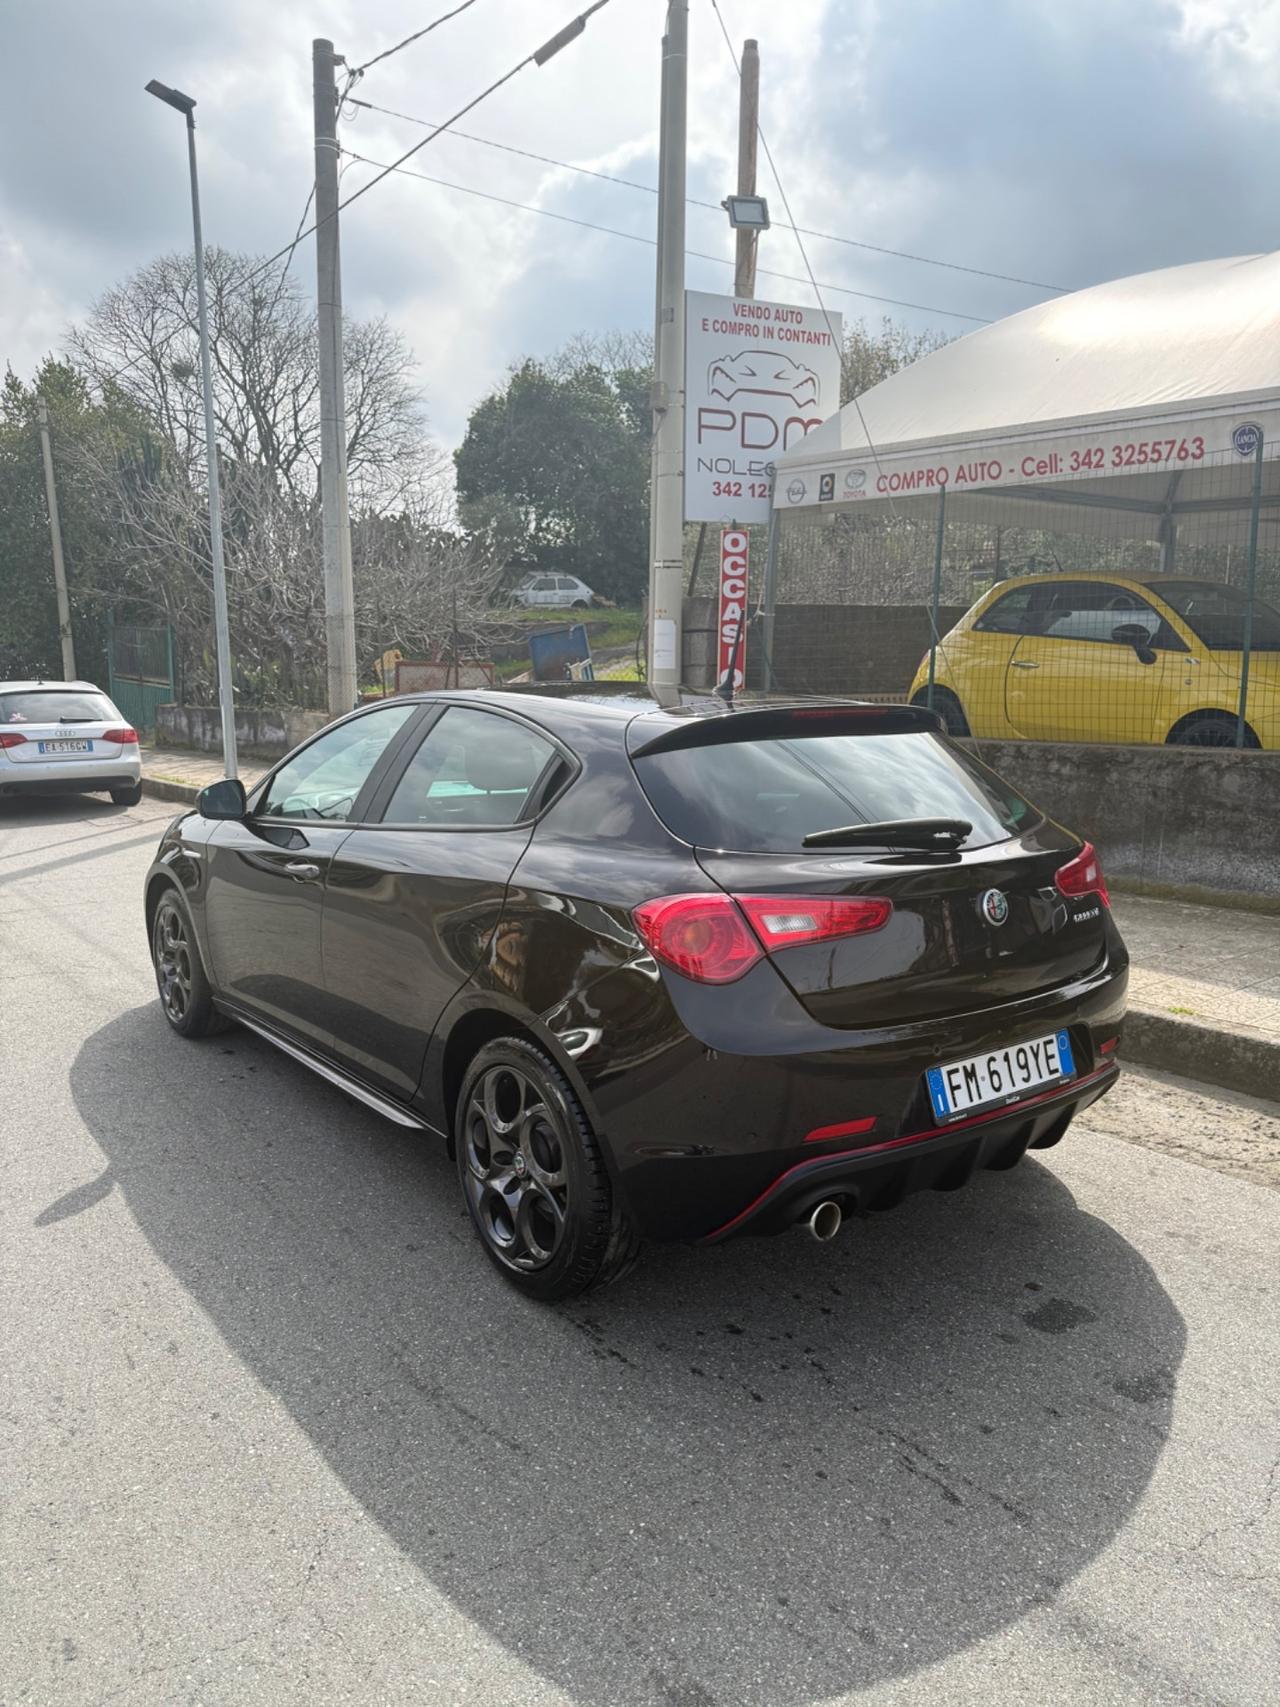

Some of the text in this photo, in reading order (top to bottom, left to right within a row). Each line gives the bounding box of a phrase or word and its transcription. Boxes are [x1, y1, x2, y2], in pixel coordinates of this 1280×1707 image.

[733, 303, 803, 324] VENDO AUTO
[702, 318, 831, 346] E COMPRO IN CONTANTI
[876, 466, 949, 493] COMPRO
[955, 460, 1002, 484] AUTO
[1021, 453, 1063, 477] Cell:
[1070, 447, 1105, 472] 342
[1111, 436, 1205, 468] 3255763
[712, 481, 742, 497] 342
[946, 1061, 983, 1108] FM
[986, 1037, 1060, 1094] 619YE
